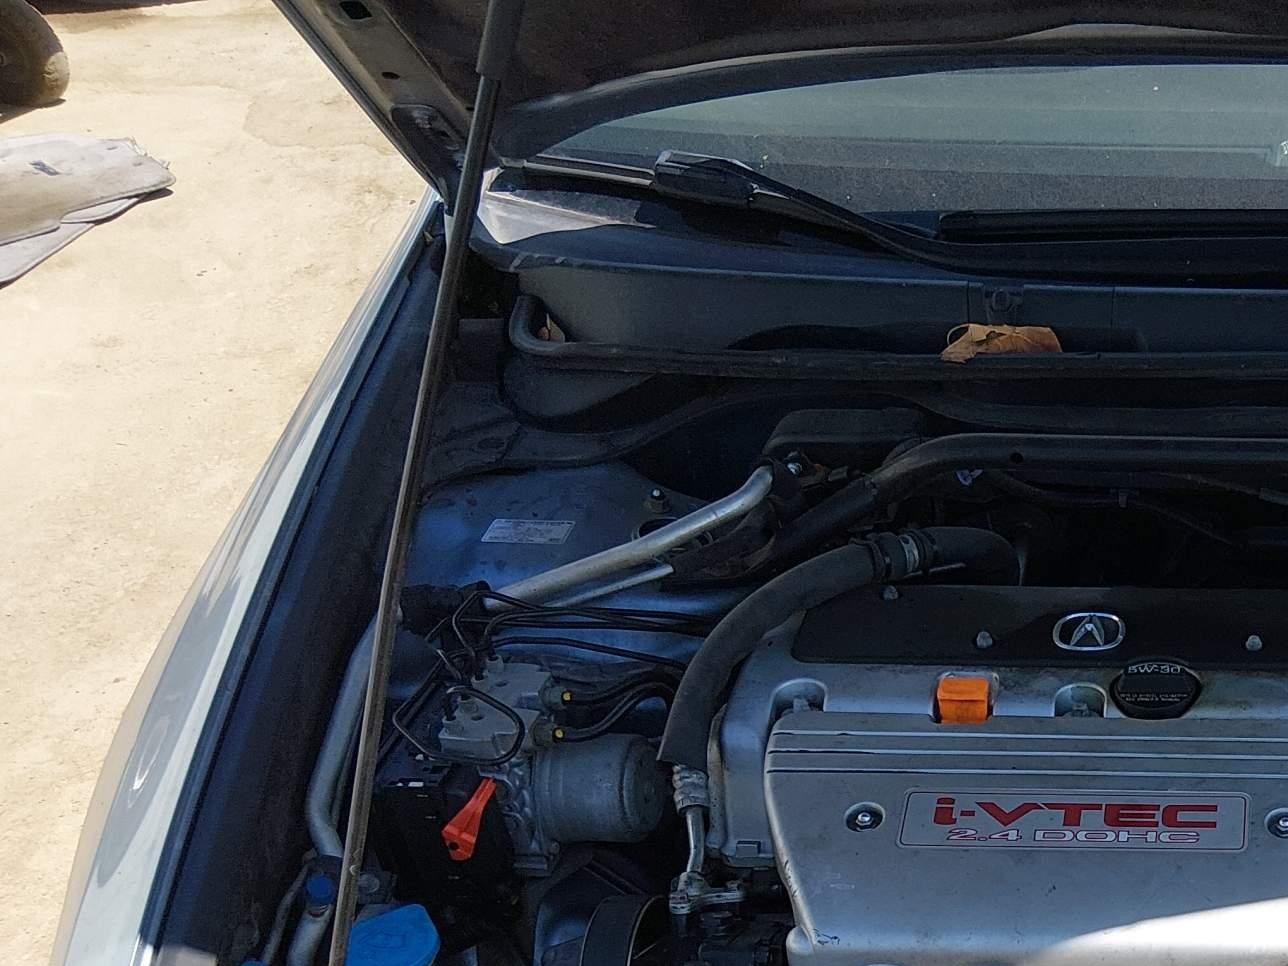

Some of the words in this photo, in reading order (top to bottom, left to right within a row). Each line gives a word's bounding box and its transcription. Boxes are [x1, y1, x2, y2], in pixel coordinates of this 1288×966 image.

[1127, 663, 1181, 674] 5W-30
[934, 797, 1218, 828] i-VTEC
[946, 828, 1023, 843] 2.4
[1033, 829, 1201, 844] DOHC
